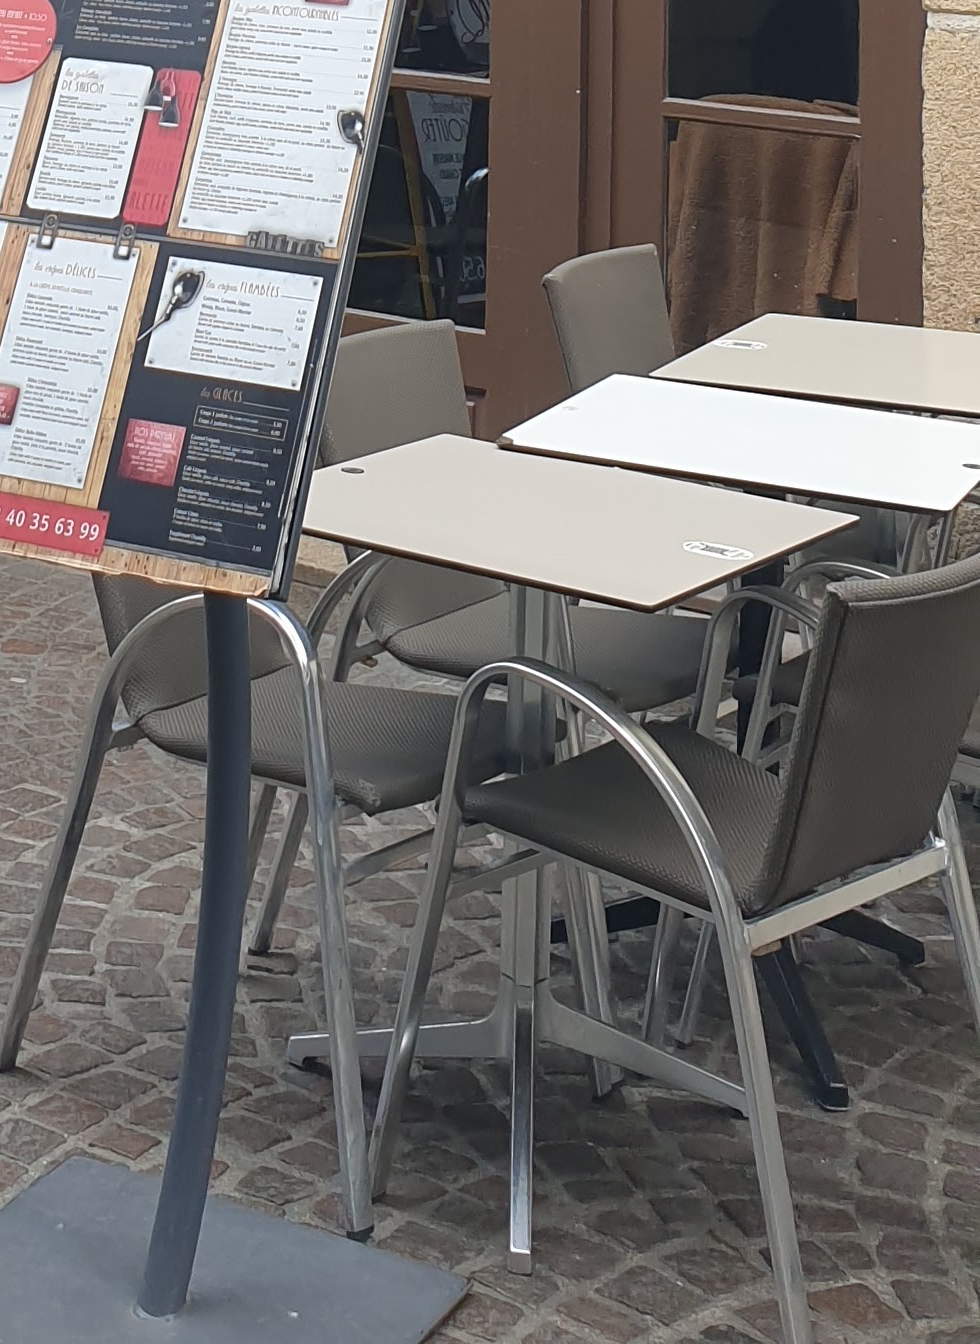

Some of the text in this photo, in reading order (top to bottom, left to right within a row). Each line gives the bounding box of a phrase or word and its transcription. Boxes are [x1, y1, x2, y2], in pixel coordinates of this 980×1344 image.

[60, 79, 105, 94] DE SAISON
[64, 261, 98, 278] DÉLICES
[239, 279, 281, 298] FLAMBÉES
[211, 387, 243, 403] GLACES
[6, 509, 26, 528] 40
[30, 513, 49, 532] 35
[54, 517, 74, 537] 63
[79, 522, 100, 541] 99
